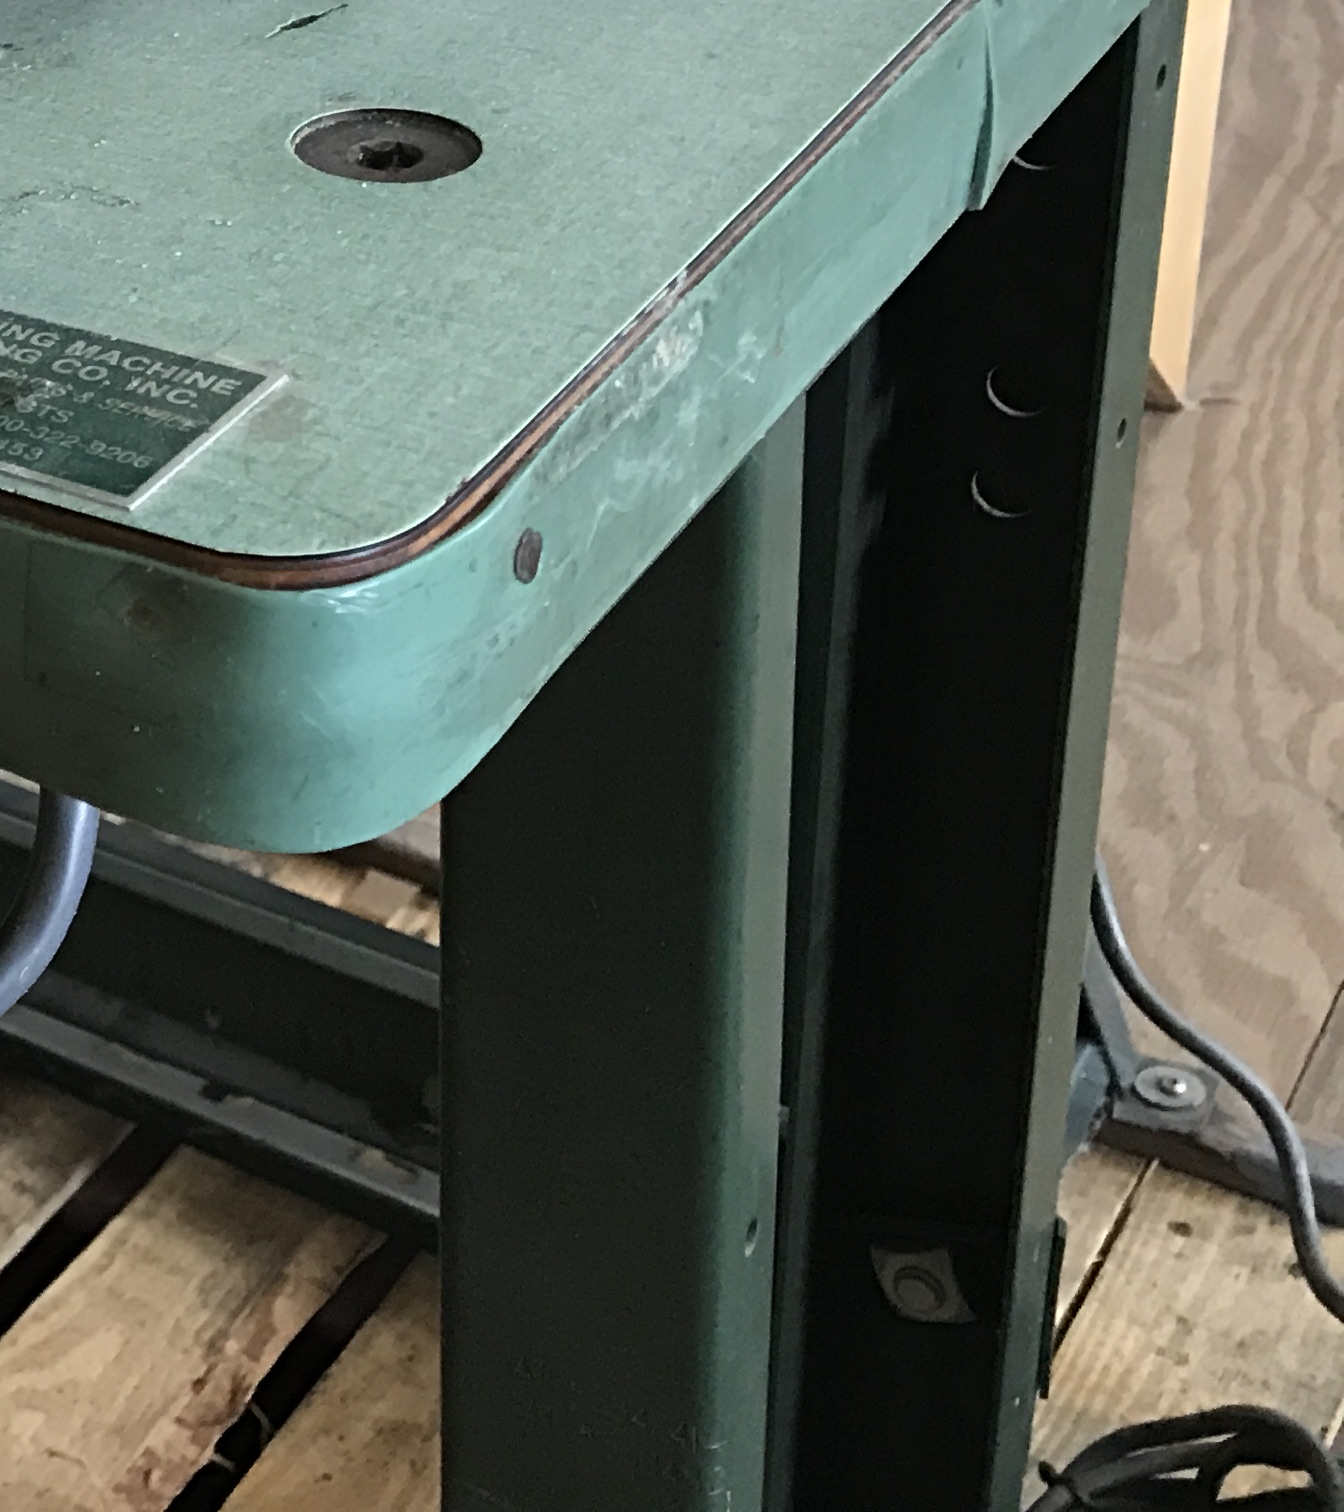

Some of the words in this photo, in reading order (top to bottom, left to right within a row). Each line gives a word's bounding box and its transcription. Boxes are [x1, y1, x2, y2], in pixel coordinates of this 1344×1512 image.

[46, 356, 124, 385] CO.
[116, 375, 211, 409] INC.
[62, 340, 245, 396] MACHINE
